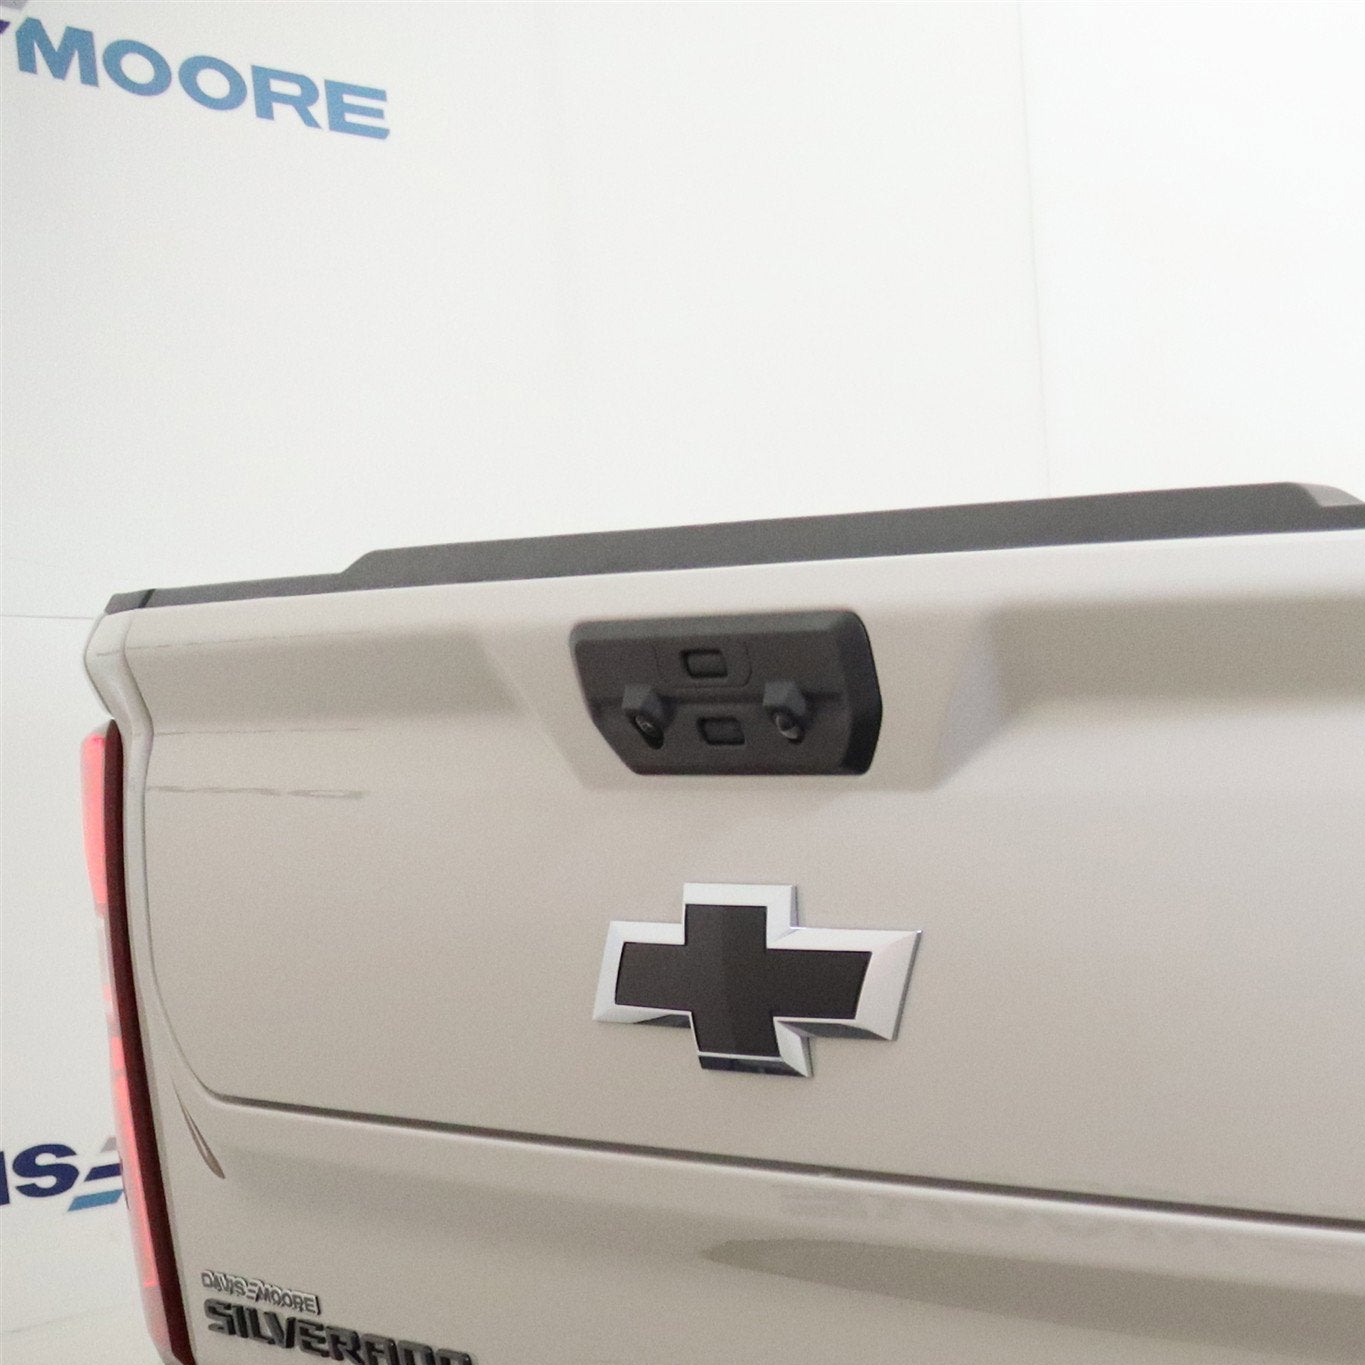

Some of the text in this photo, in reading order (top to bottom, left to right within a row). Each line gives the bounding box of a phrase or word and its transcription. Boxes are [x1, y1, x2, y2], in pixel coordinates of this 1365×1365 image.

[15, 16, 390, 140] MOORE
[201, 1270, 321, 1315] DAVIS MOORE
